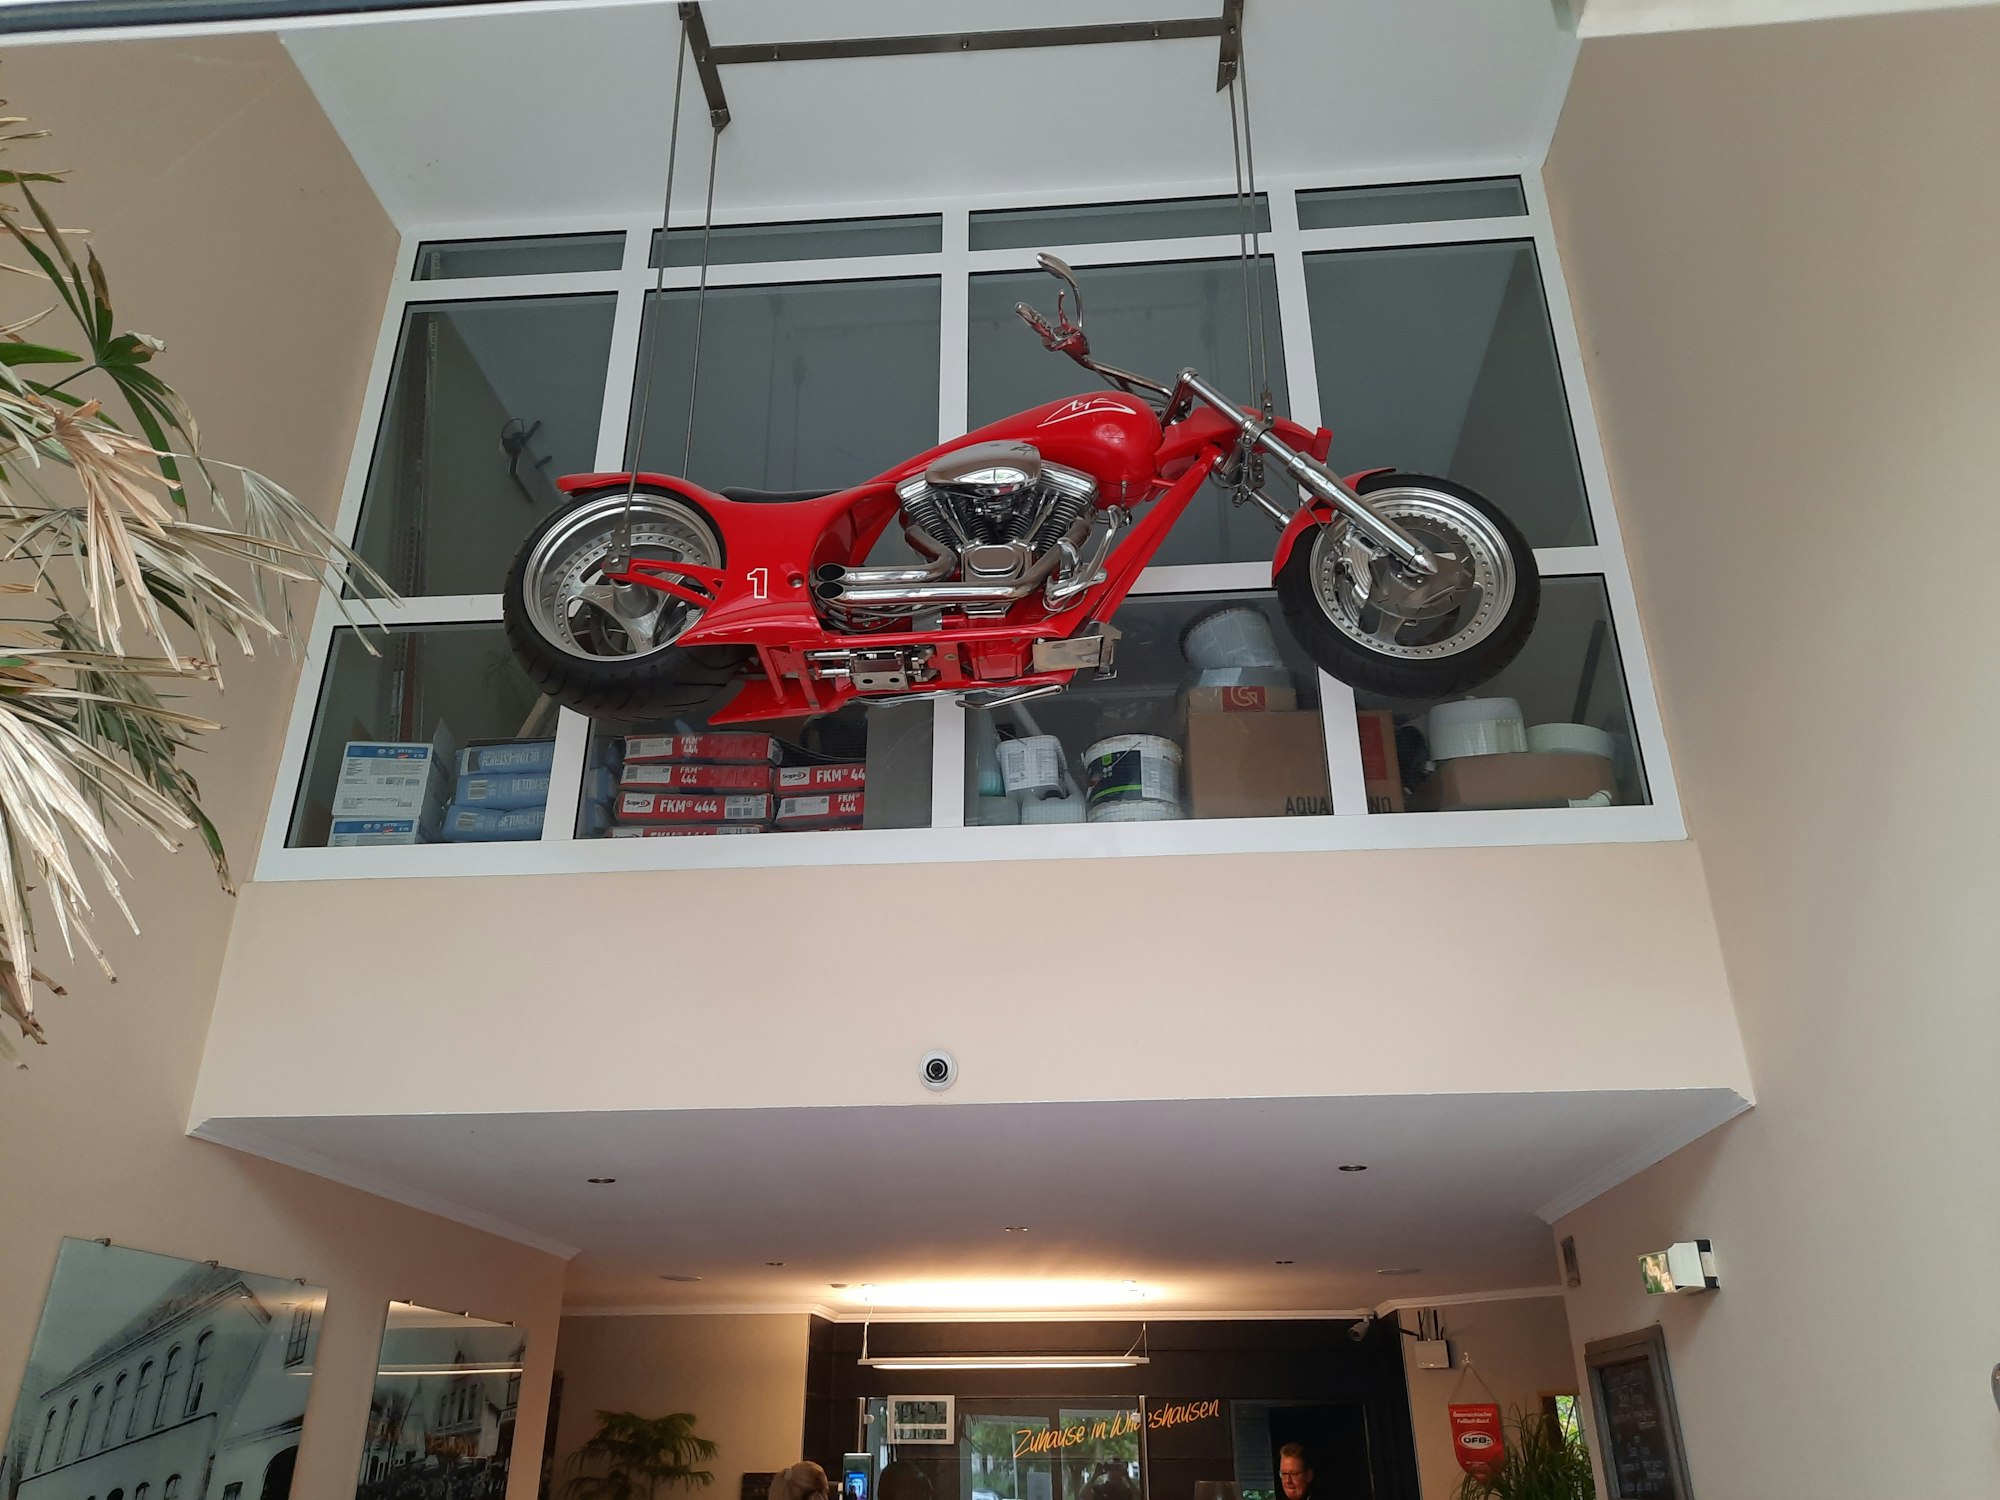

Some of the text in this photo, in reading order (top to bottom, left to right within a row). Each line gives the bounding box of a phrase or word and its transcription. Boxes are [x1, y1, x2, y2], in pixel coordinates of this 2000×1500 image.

[746, 567, 768, 599] 1
[682, 744, 698, 754] 444
[680, 774, 697, 784] 444
[625, 799, 648, 808] Sopro
[694, 799, 718, 813] 444
[839, 802, 856, 813] 444
[1013, 1425, 1085, 1458] Zuhause
[1091, 1420, 1106, 1440] in
